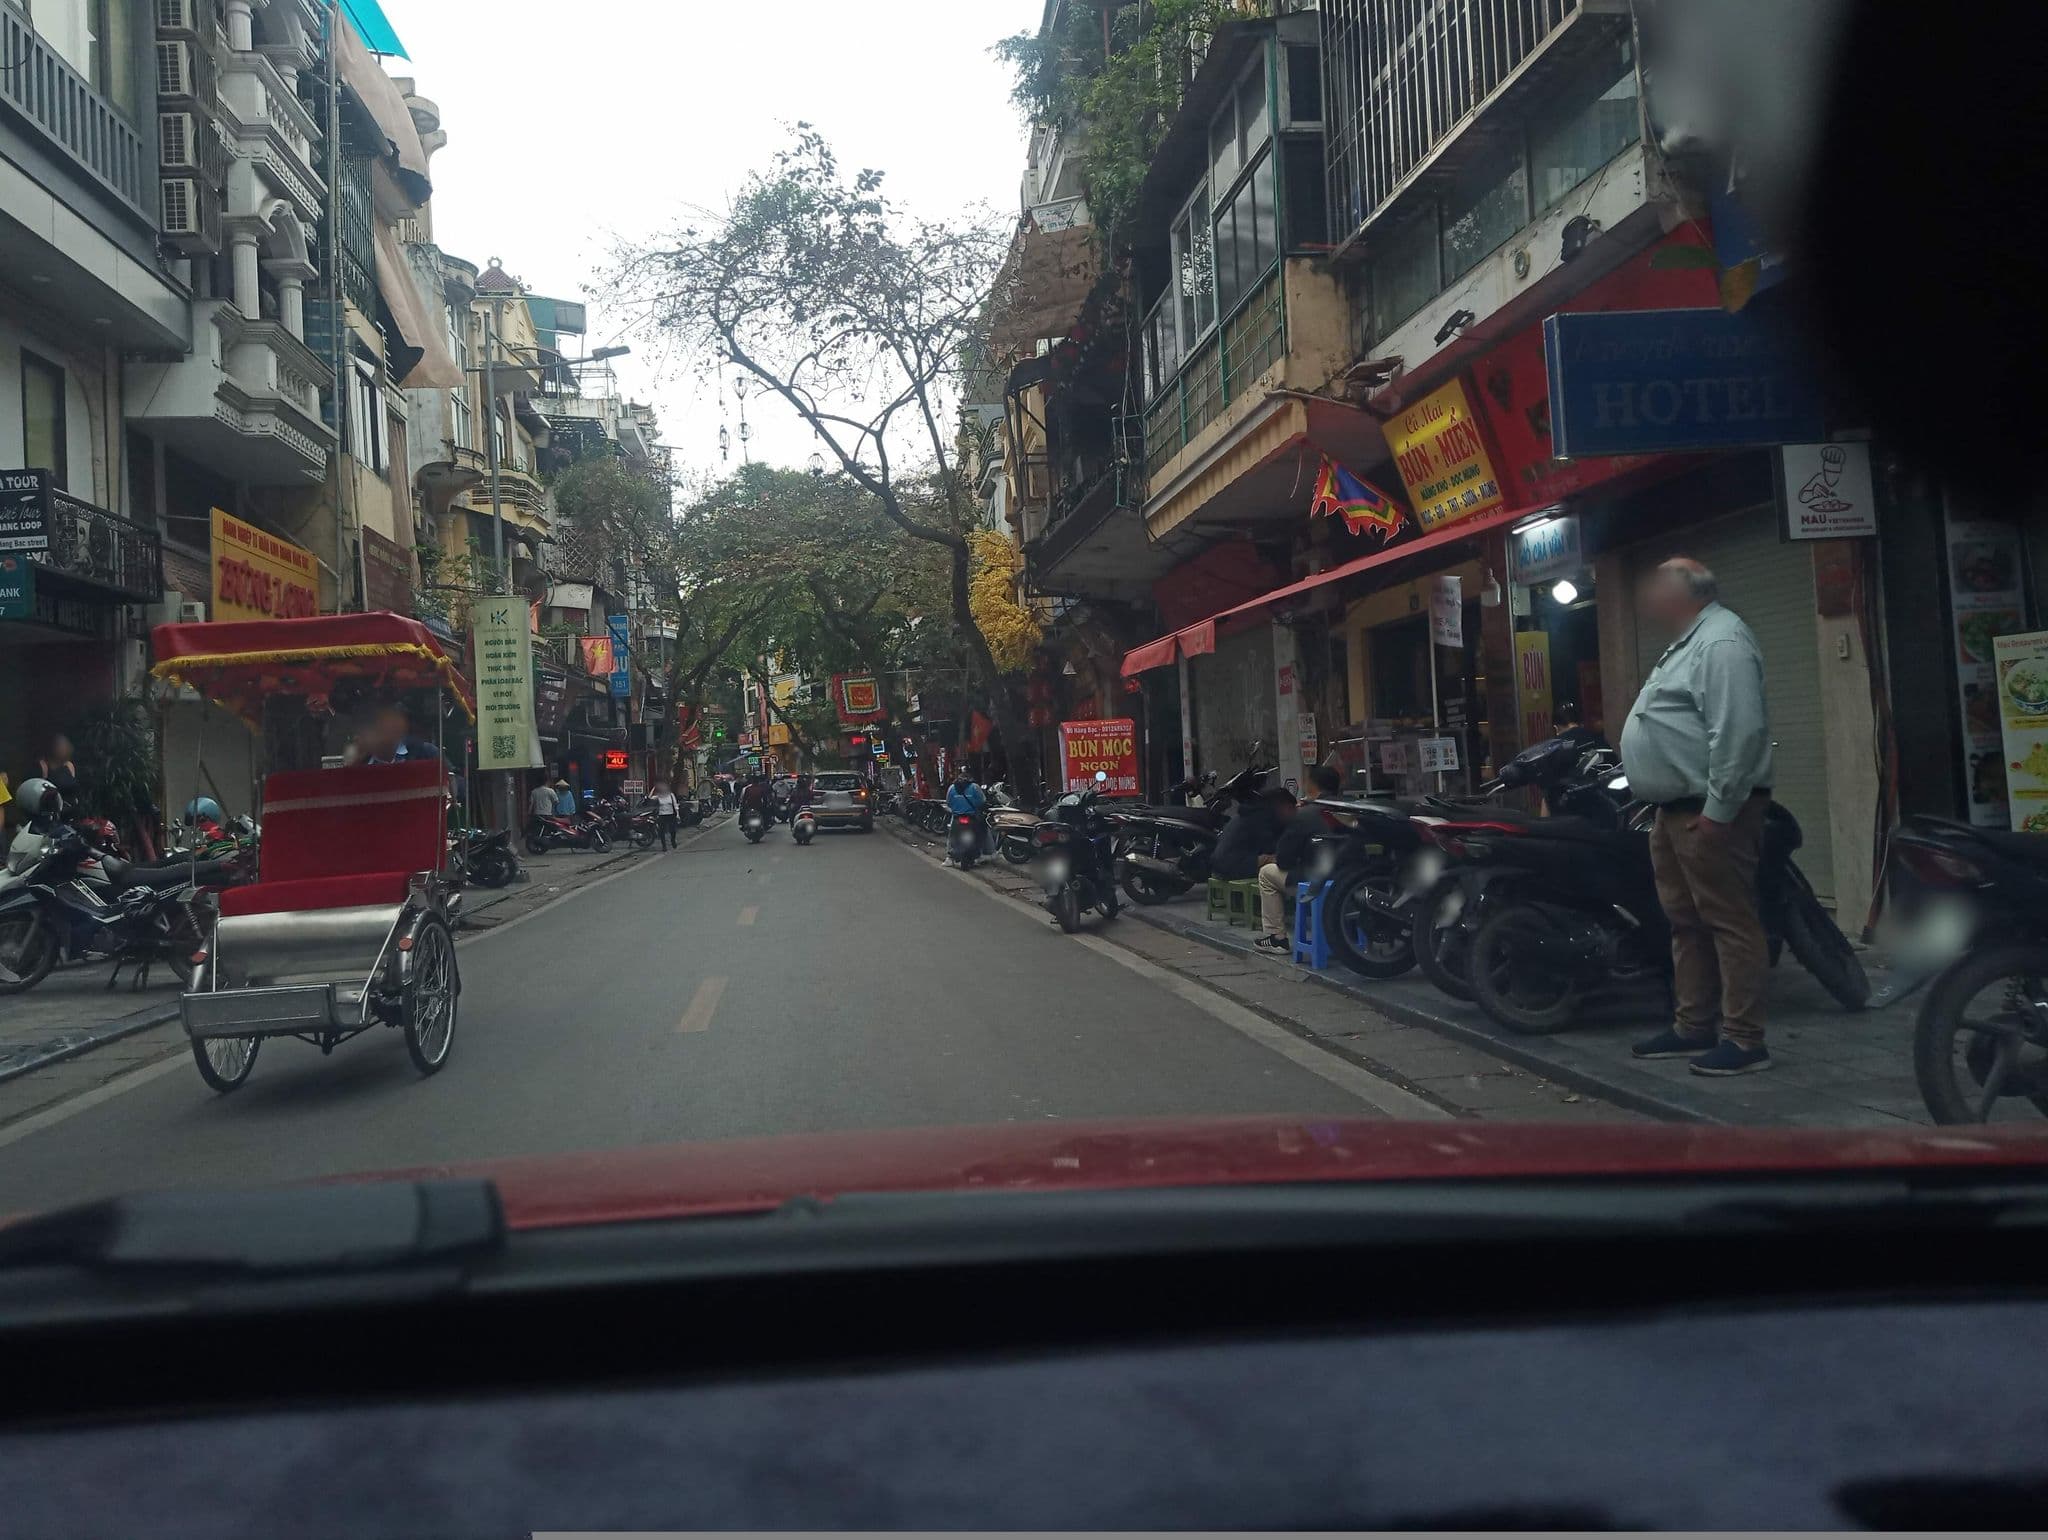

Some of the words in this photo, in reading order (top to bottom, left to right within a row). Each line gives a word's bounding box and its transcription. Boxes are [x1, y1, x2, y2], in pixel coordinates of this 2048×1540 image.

[1595, 378, 1789, 426] HOTEL
[1398, 440, 1435, 487] BÚN
[1435, 406, 1482, 468] MIẾN
[6, 475, 40, 489] TOUR
[20, 521, 42, 530] LOOP
[1523, 643, 1545, 690] BÚN
[1068, 735, 1098, 758] BÚN
[1102, 737, 1133, 760] MỌC
[611, 757, 624, 765] 4U
